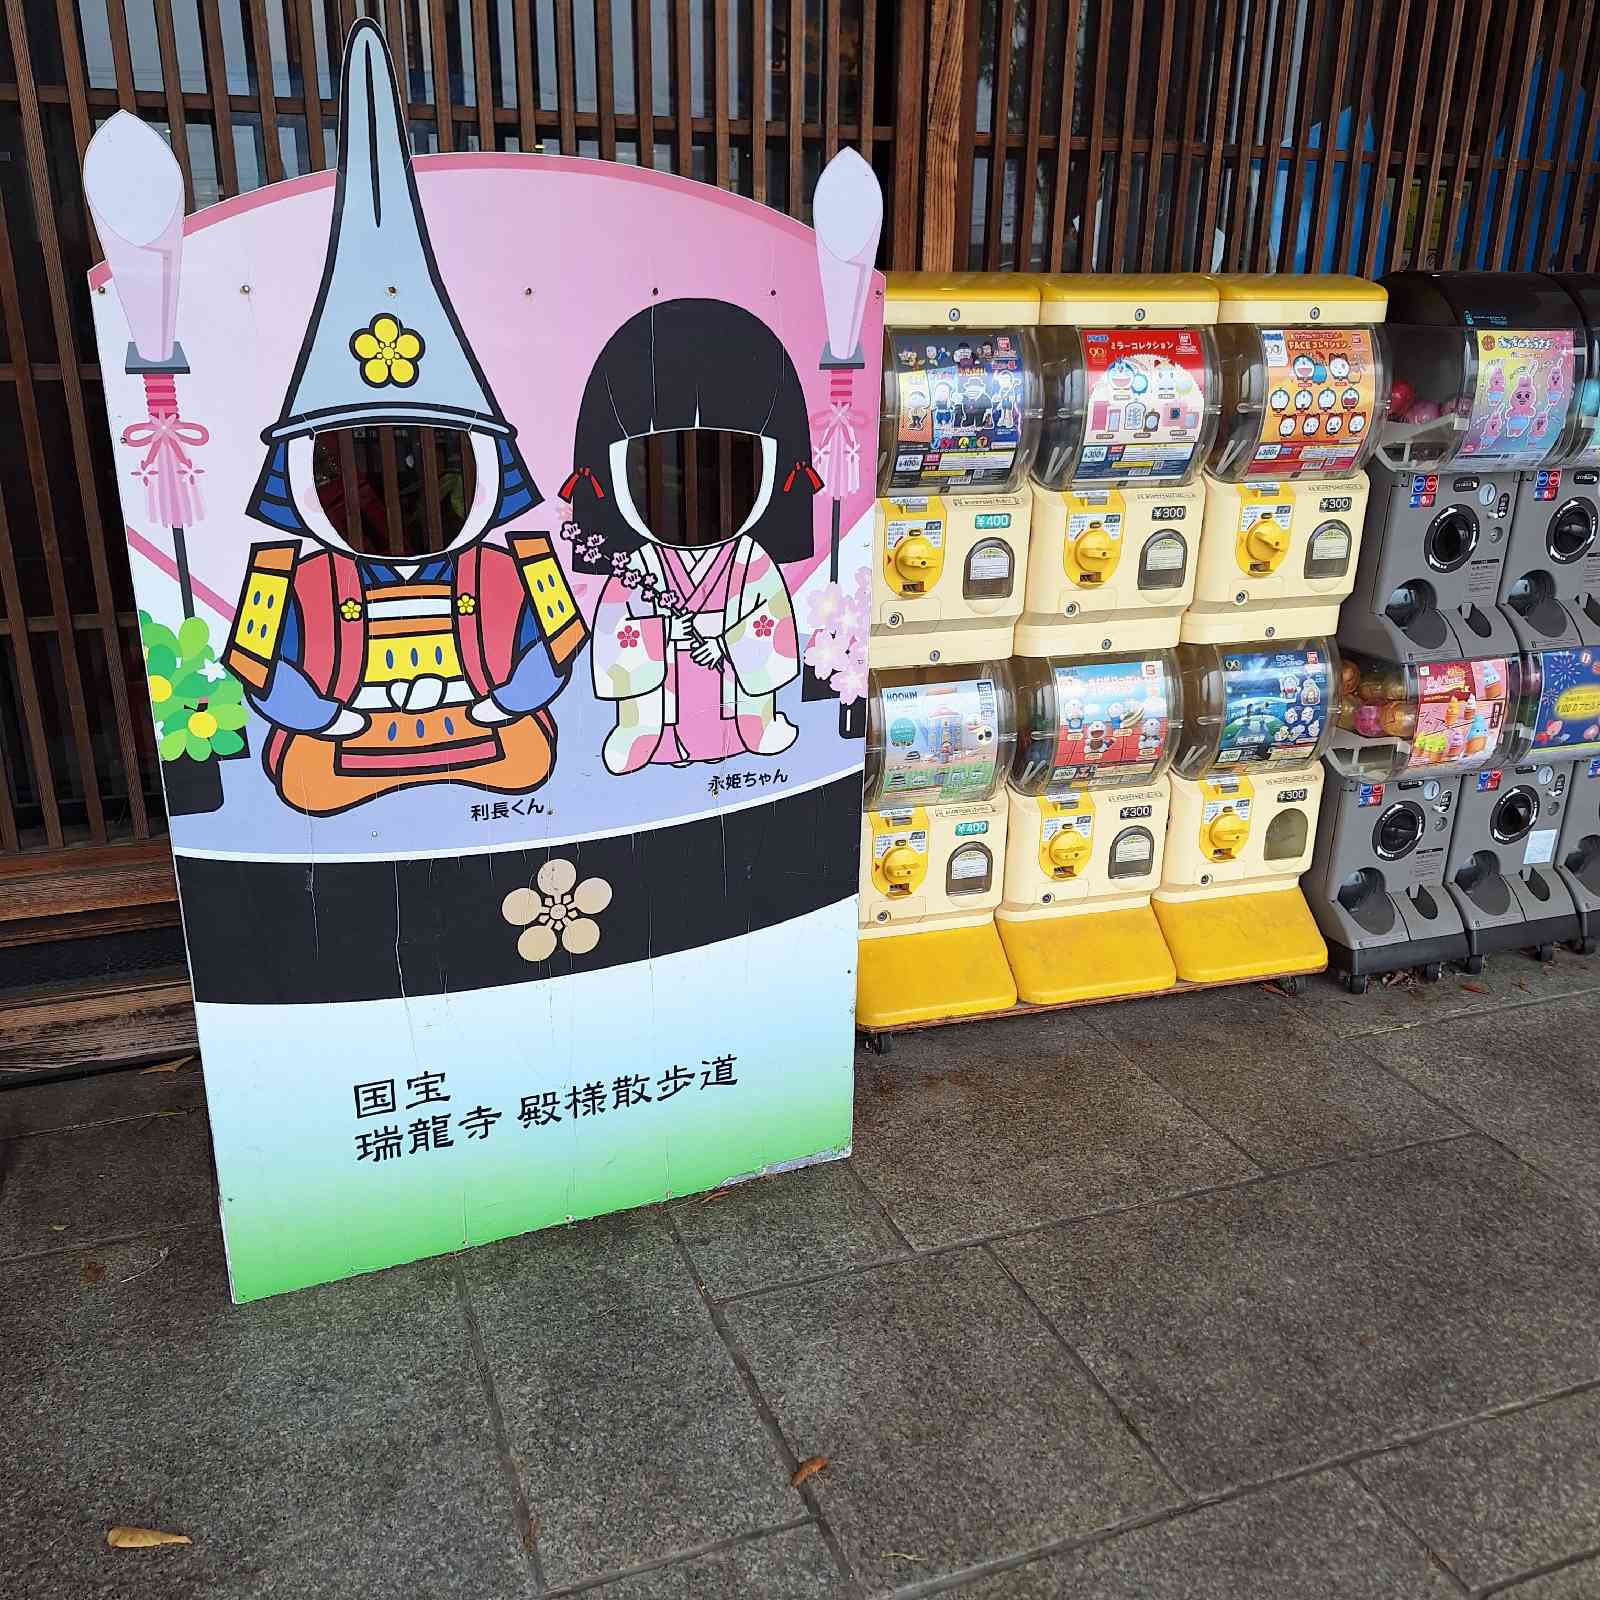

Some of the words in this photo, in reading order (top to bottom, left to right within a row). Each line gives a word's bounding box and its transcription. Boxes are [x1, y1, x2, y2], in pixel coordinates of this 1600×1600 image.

[1110, 341, 1174, 350] ミラーコレクション
[1321, 498, 1349, 509] ¥300
[1153, 507, 1184, 518] ¥300
[976, 514, 1009, 527] ¥400
[708, 769, 788, 791] 永姫ちゃん
[1279, 790, 1305, 800] ¥300
[471, 798, 545, 821] 利長くん
[1121, 806, 1150, 817] ¥300
[958, 822, 987, 834] ¥400
[354, 1071, 450, 1119] 国宝
[354, 1105, 503, 1162] 瑞龍寺
[517, 1054, 739, 1129] 殿様散歩道
